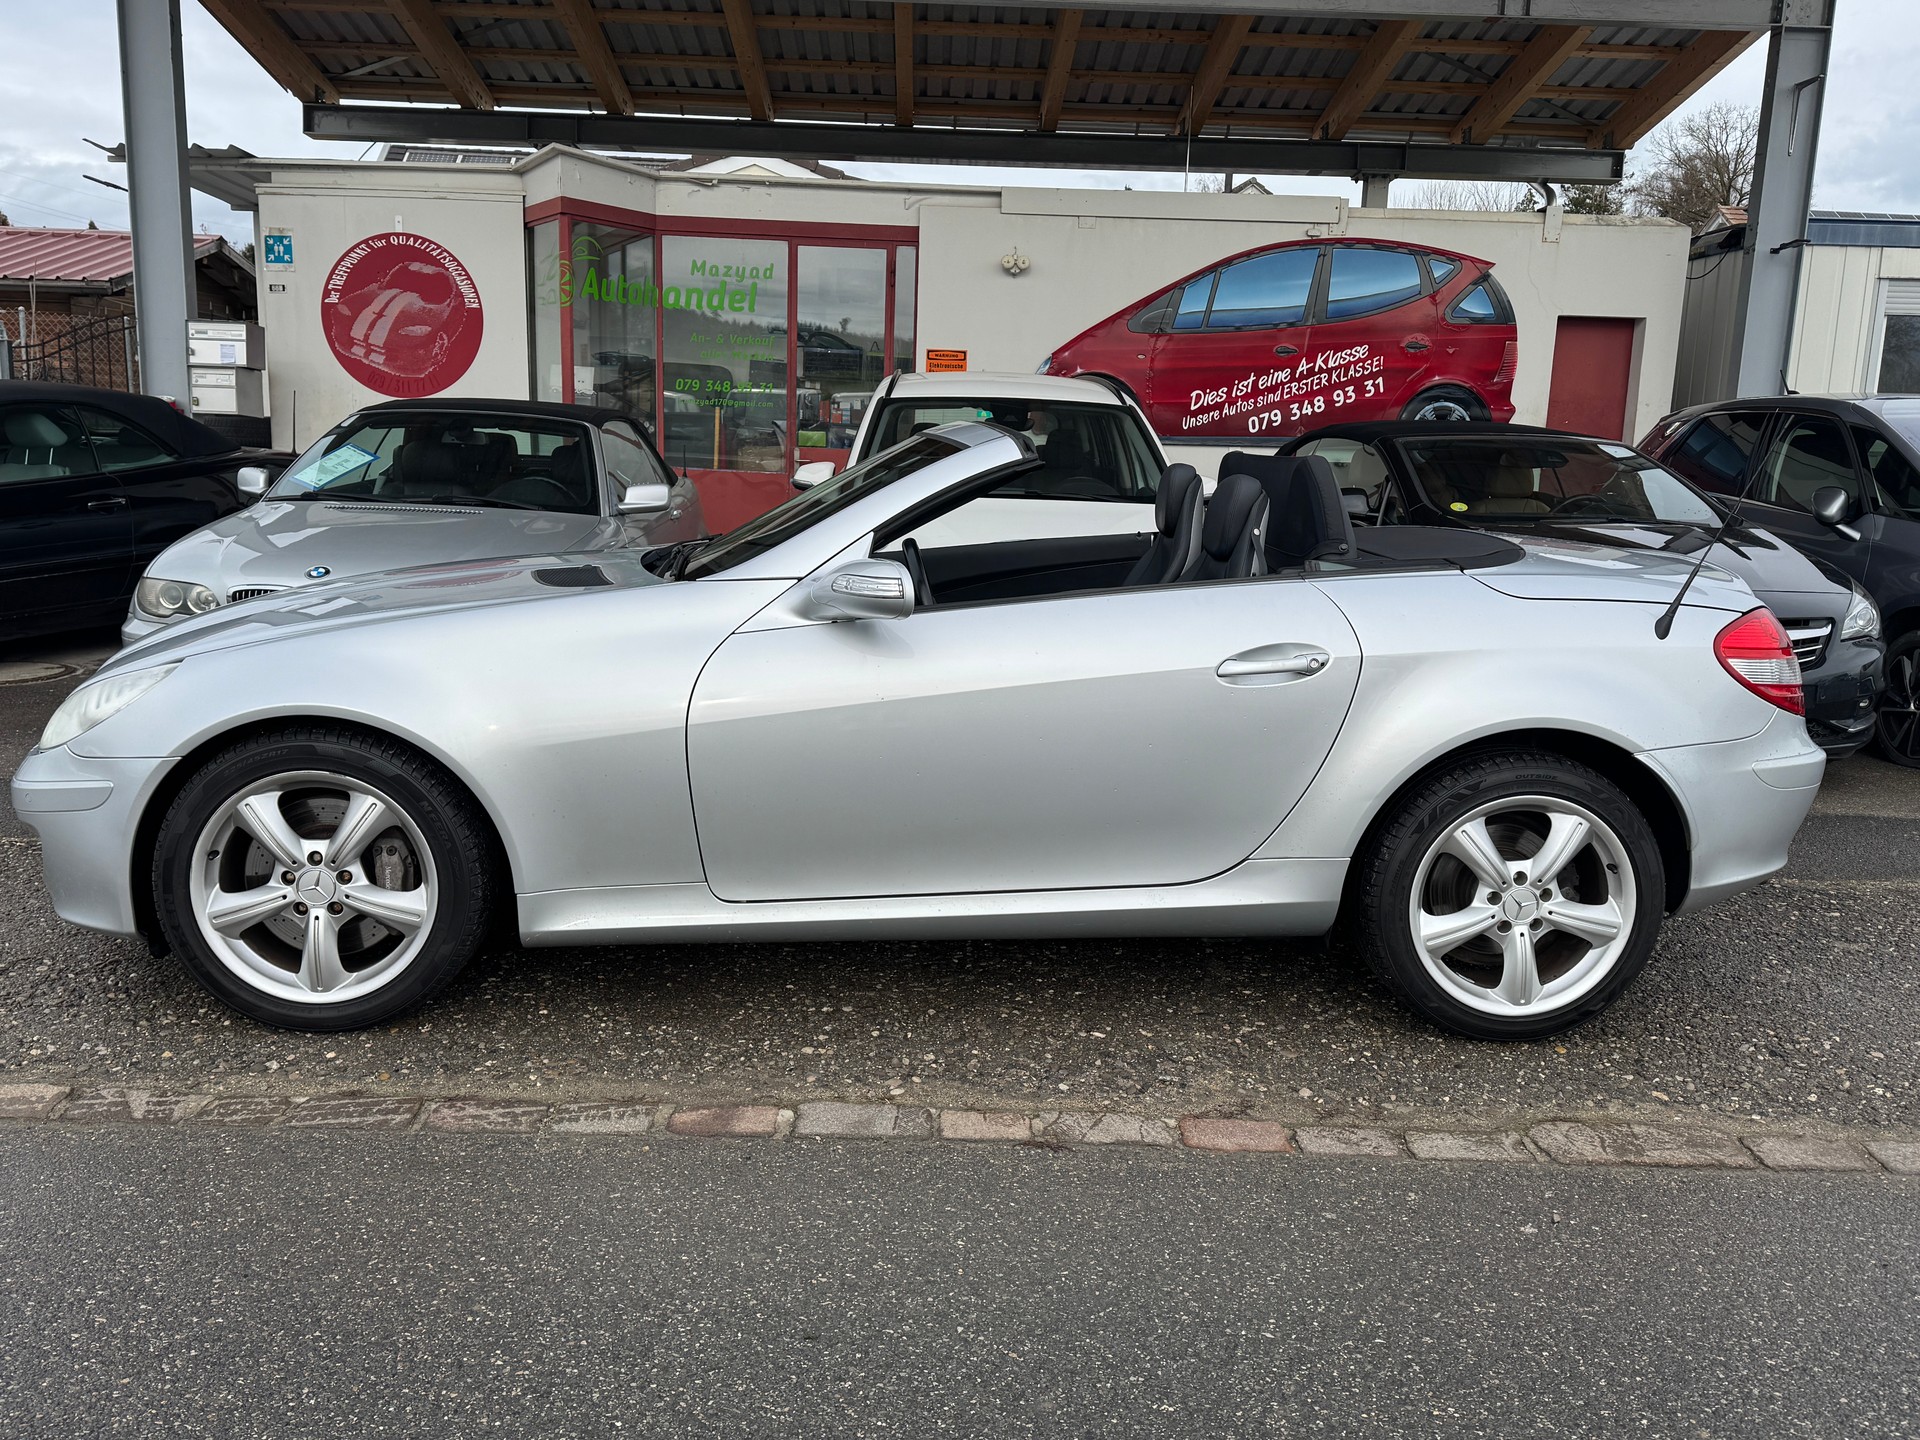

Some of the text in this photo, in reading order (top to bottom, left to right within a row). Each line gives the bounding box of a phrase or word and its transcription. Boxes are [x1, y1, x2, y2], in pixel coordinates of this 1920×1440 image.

[324, 235, 481, 309] Der TREFFPUNKT für QUALITÄTSOCCASIONEN
[580, 267, 758, 313] Autohandel
[690, 259, 775, 283] Mazyad
[730, 334, 775, 349] Verkauf
[675, 379, 700, 391] 079
[705, 380, 731, 392] 348
[760, 382, 774, 393] 31
[1182, 356, 1384, 430] Unsere Autos sind ERSTER KLASSE!
[1190, 344, 1369, 411] Dies ist eine A-Klasse
[1248, 377, 1385, 434] 079 348 93 31
[1515, 773, 1559, 781] OUTSIDE
